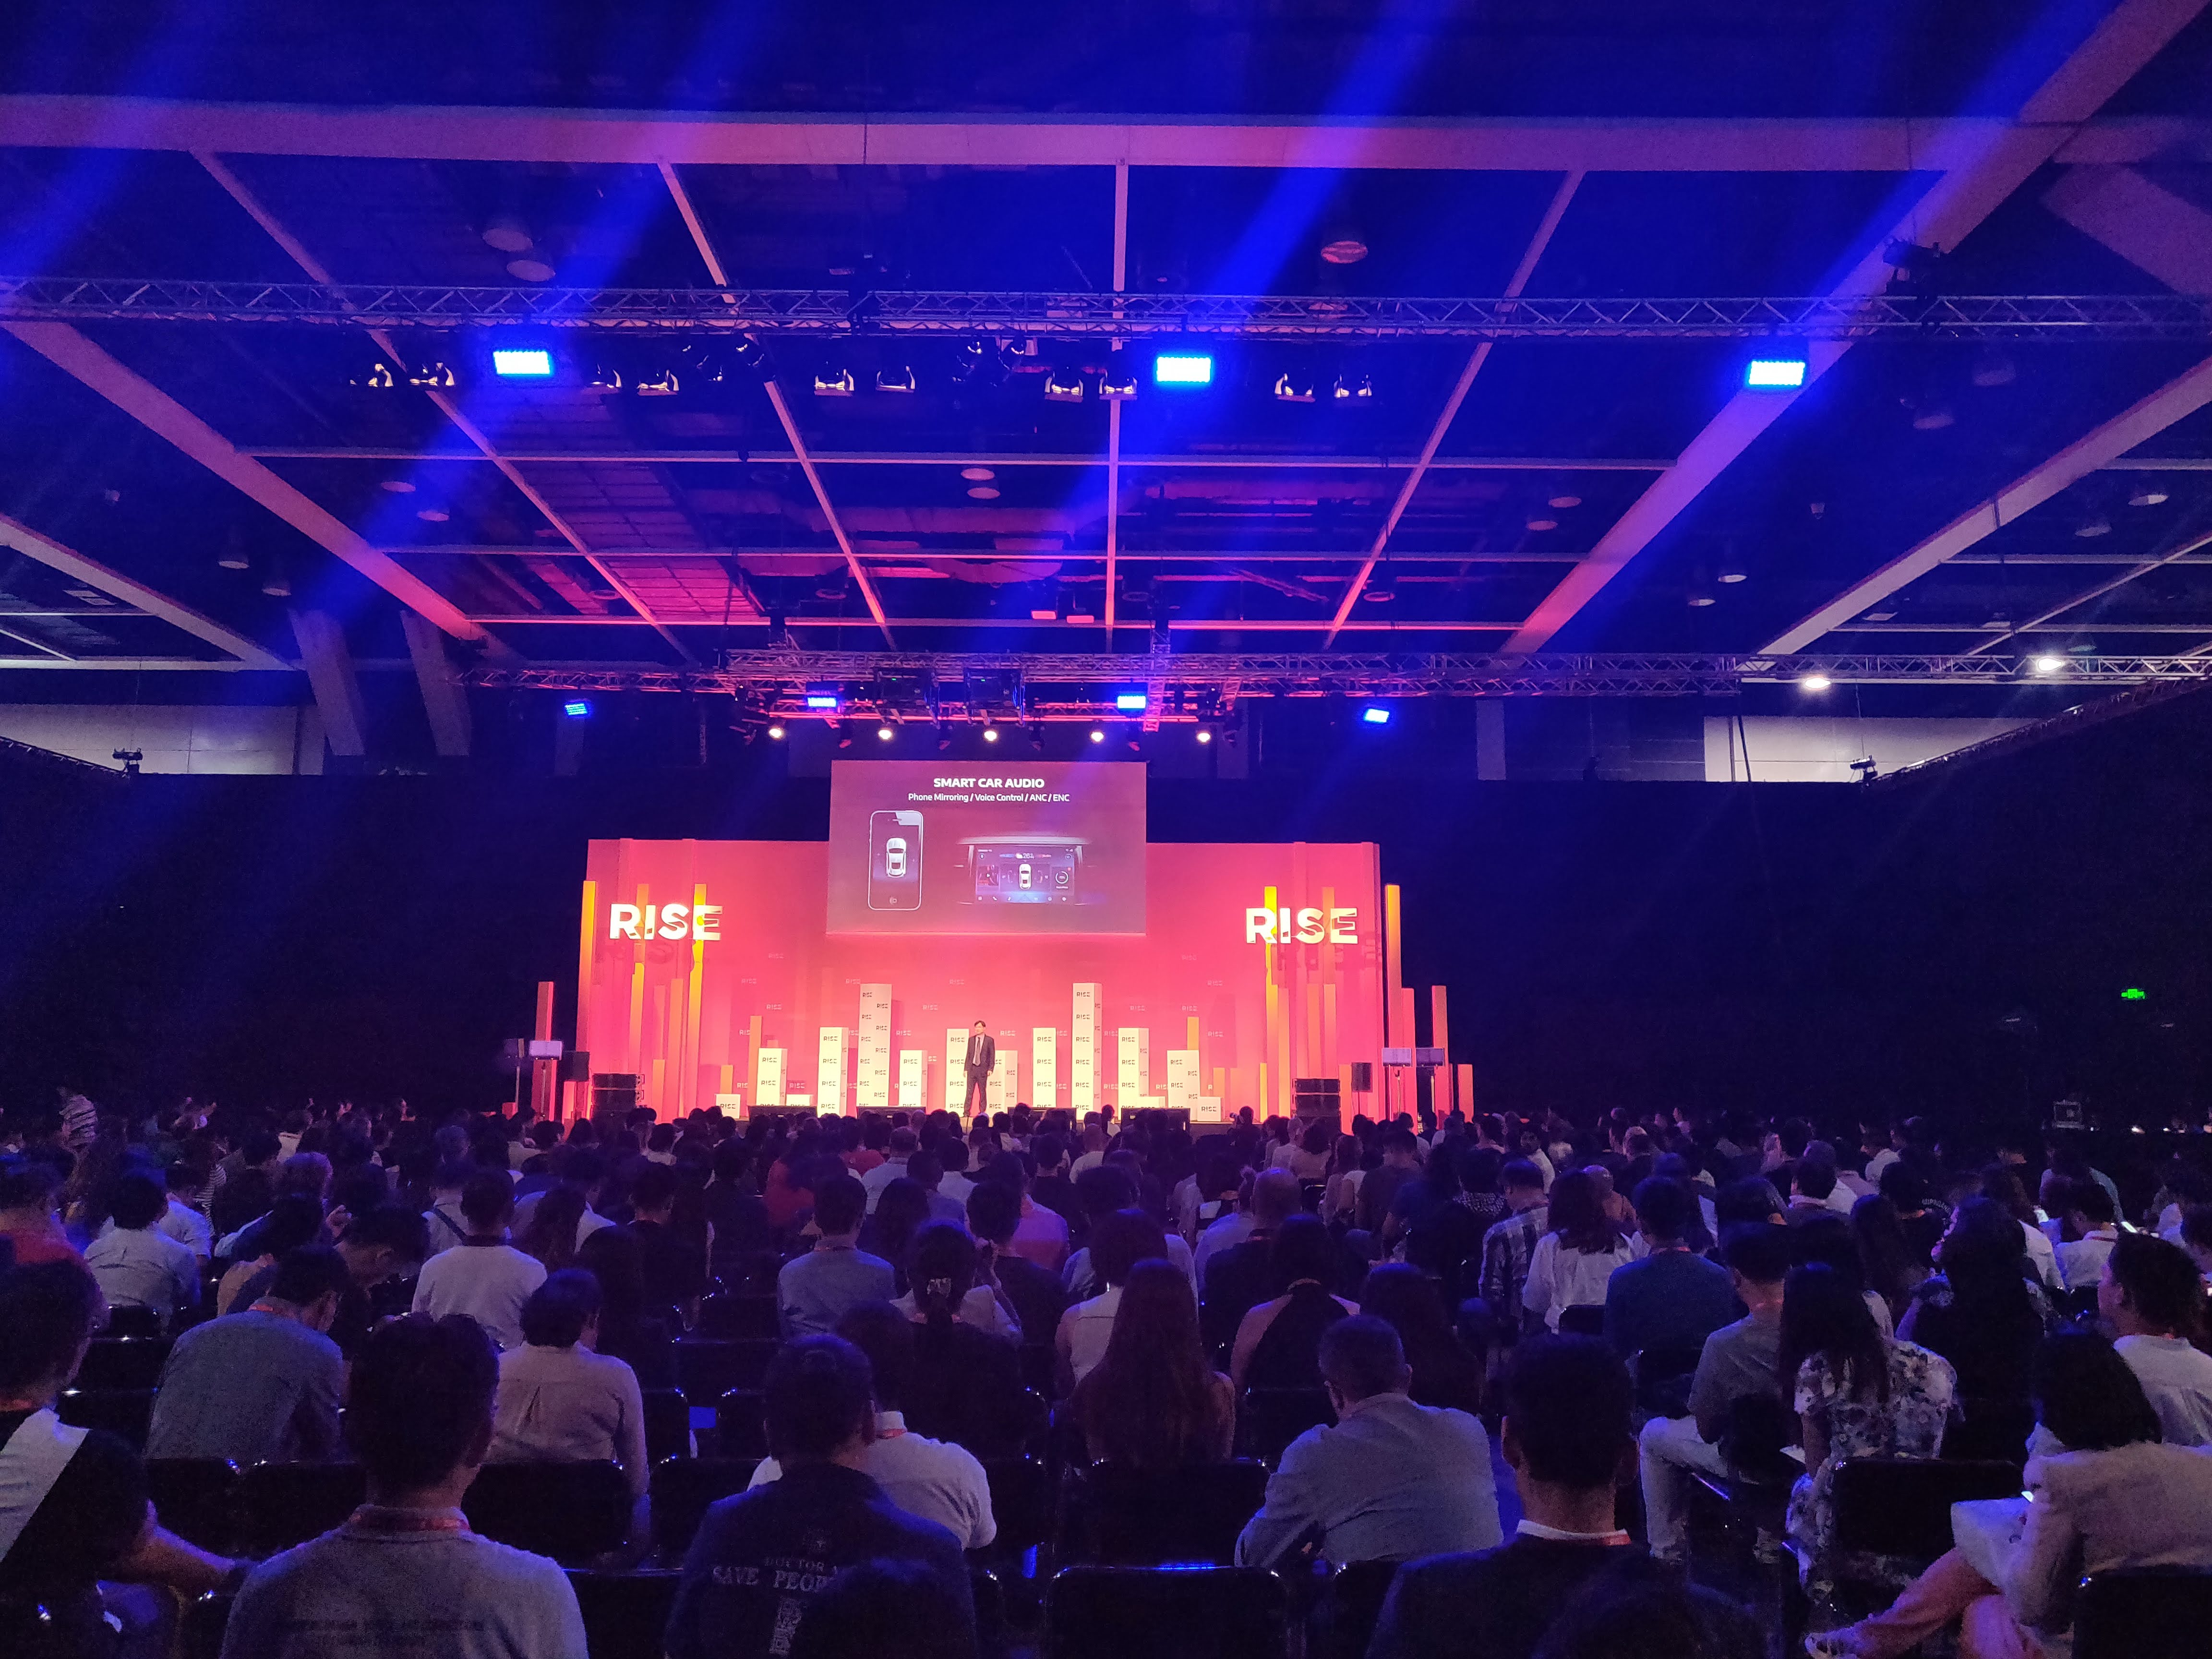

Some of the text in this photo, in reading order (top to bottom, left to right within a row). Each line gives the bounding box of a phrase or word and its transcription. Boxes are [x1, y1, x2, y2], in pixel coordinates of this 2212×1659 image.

[934, 778, 1045, 788] SMART CAR AUDIO
[934, 793, 968, 803] Mirroring
[997, 793, 1023, 801] Control
[610, 903, 722, 940] RISE
[1246, 908, 1358, 944] RISE
